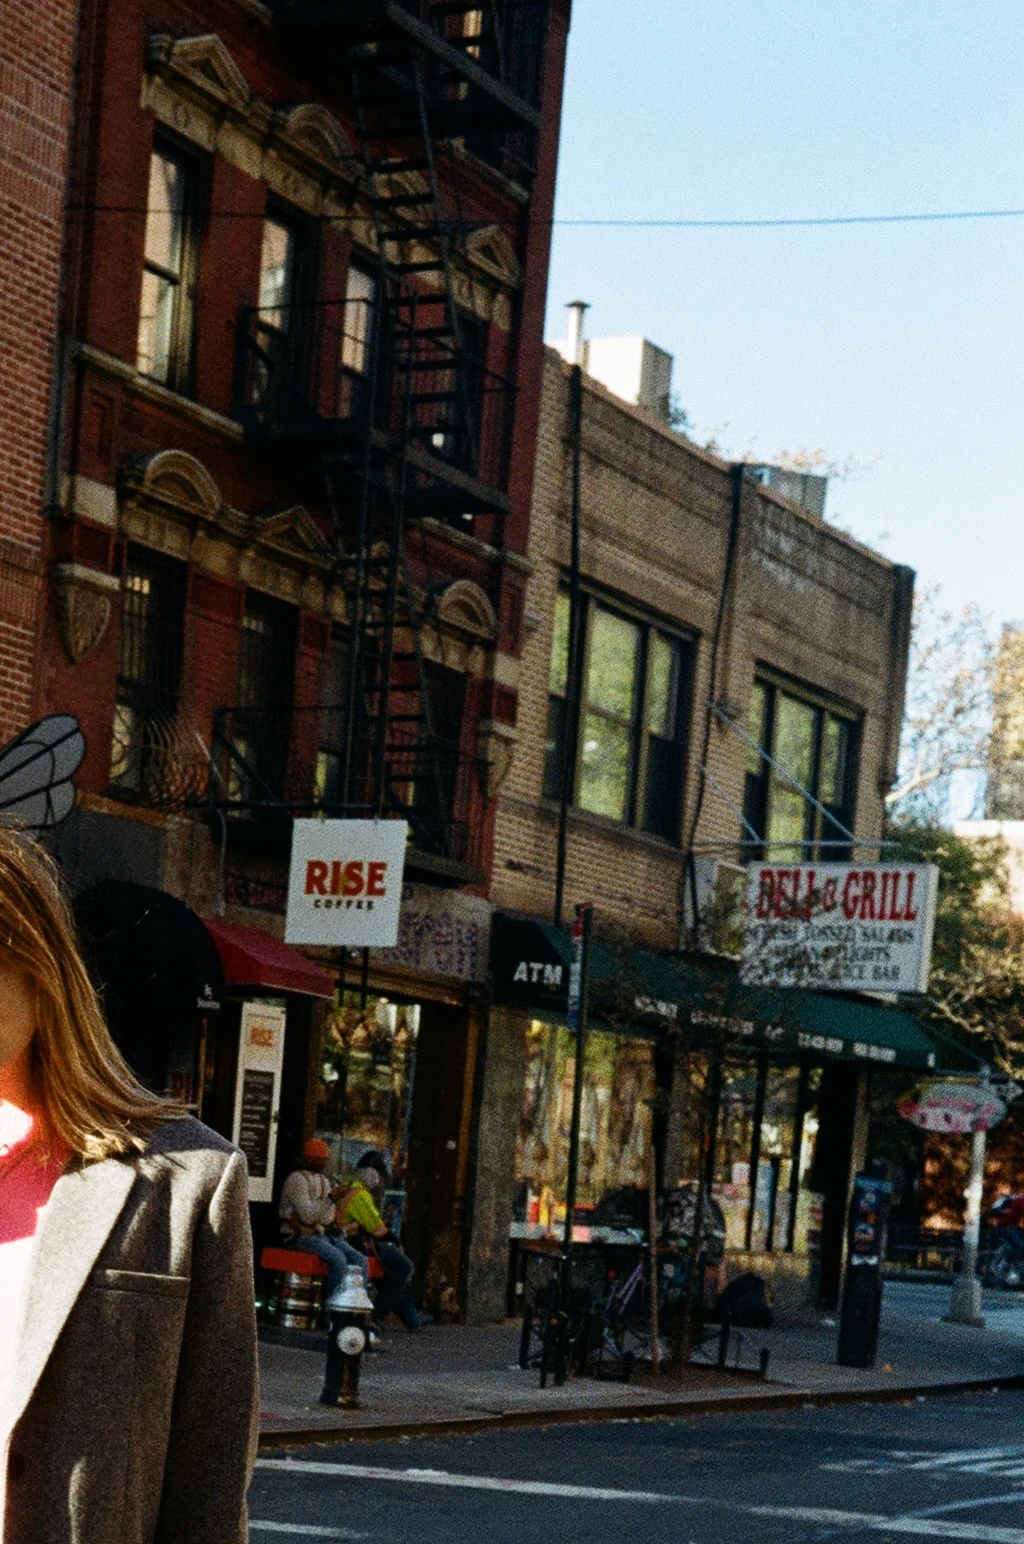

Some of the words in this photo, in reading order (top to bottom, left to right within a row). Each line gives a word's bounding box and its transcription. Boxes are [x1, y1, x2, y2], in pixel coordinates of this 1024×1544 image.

[304, 860, 387, 897] RISE
[313, 899, 374, 911] COFFEE
[756, 868, 816, 922] DELI
[842, 869, 919, 922] GRILL
[513, 961, 563, 986] ATM
